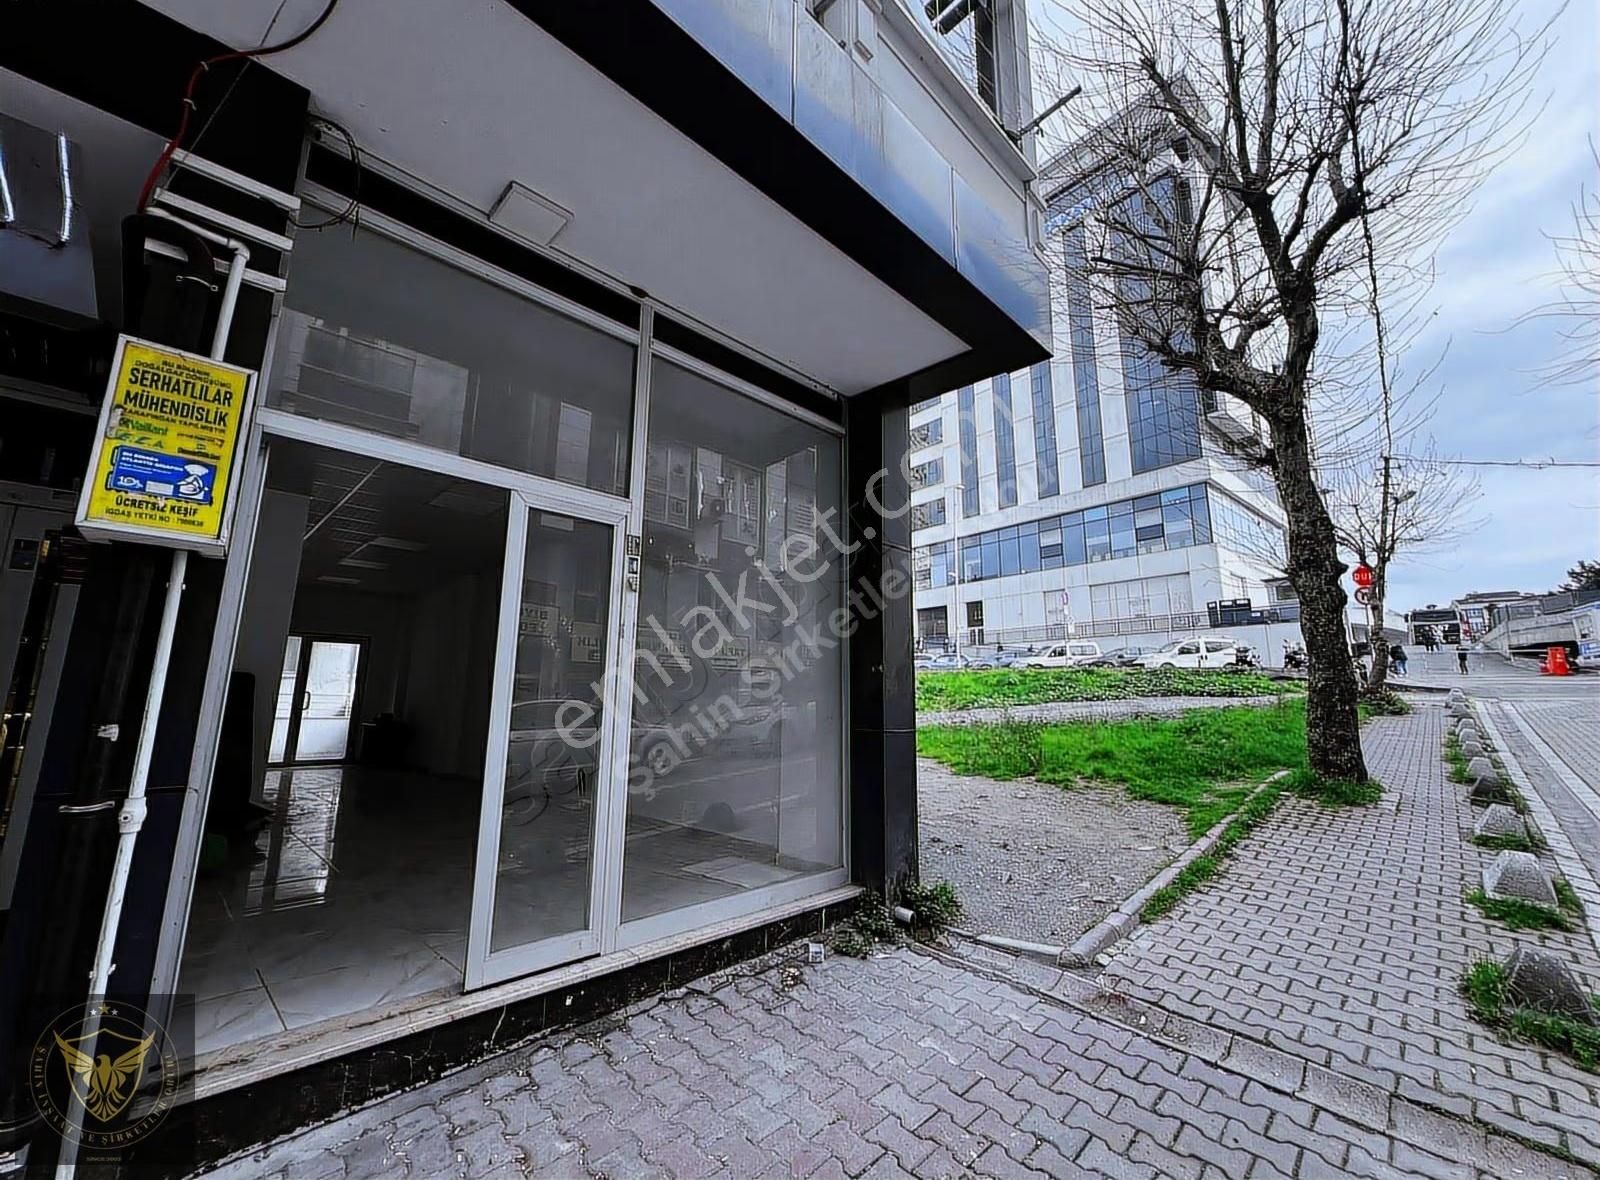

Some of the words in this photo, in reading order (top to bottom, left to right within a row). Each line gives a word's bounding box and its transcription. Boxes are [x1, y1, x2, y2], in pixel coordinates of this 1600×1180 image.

[128, 367, 234, 408] SERHATLILAR
[123, 388, 229, 428] MÜHENDİSLİK
[115, 494, 167, 514] ÜCRETSİZ
[169, 503, 200, 518] KEŞİF
